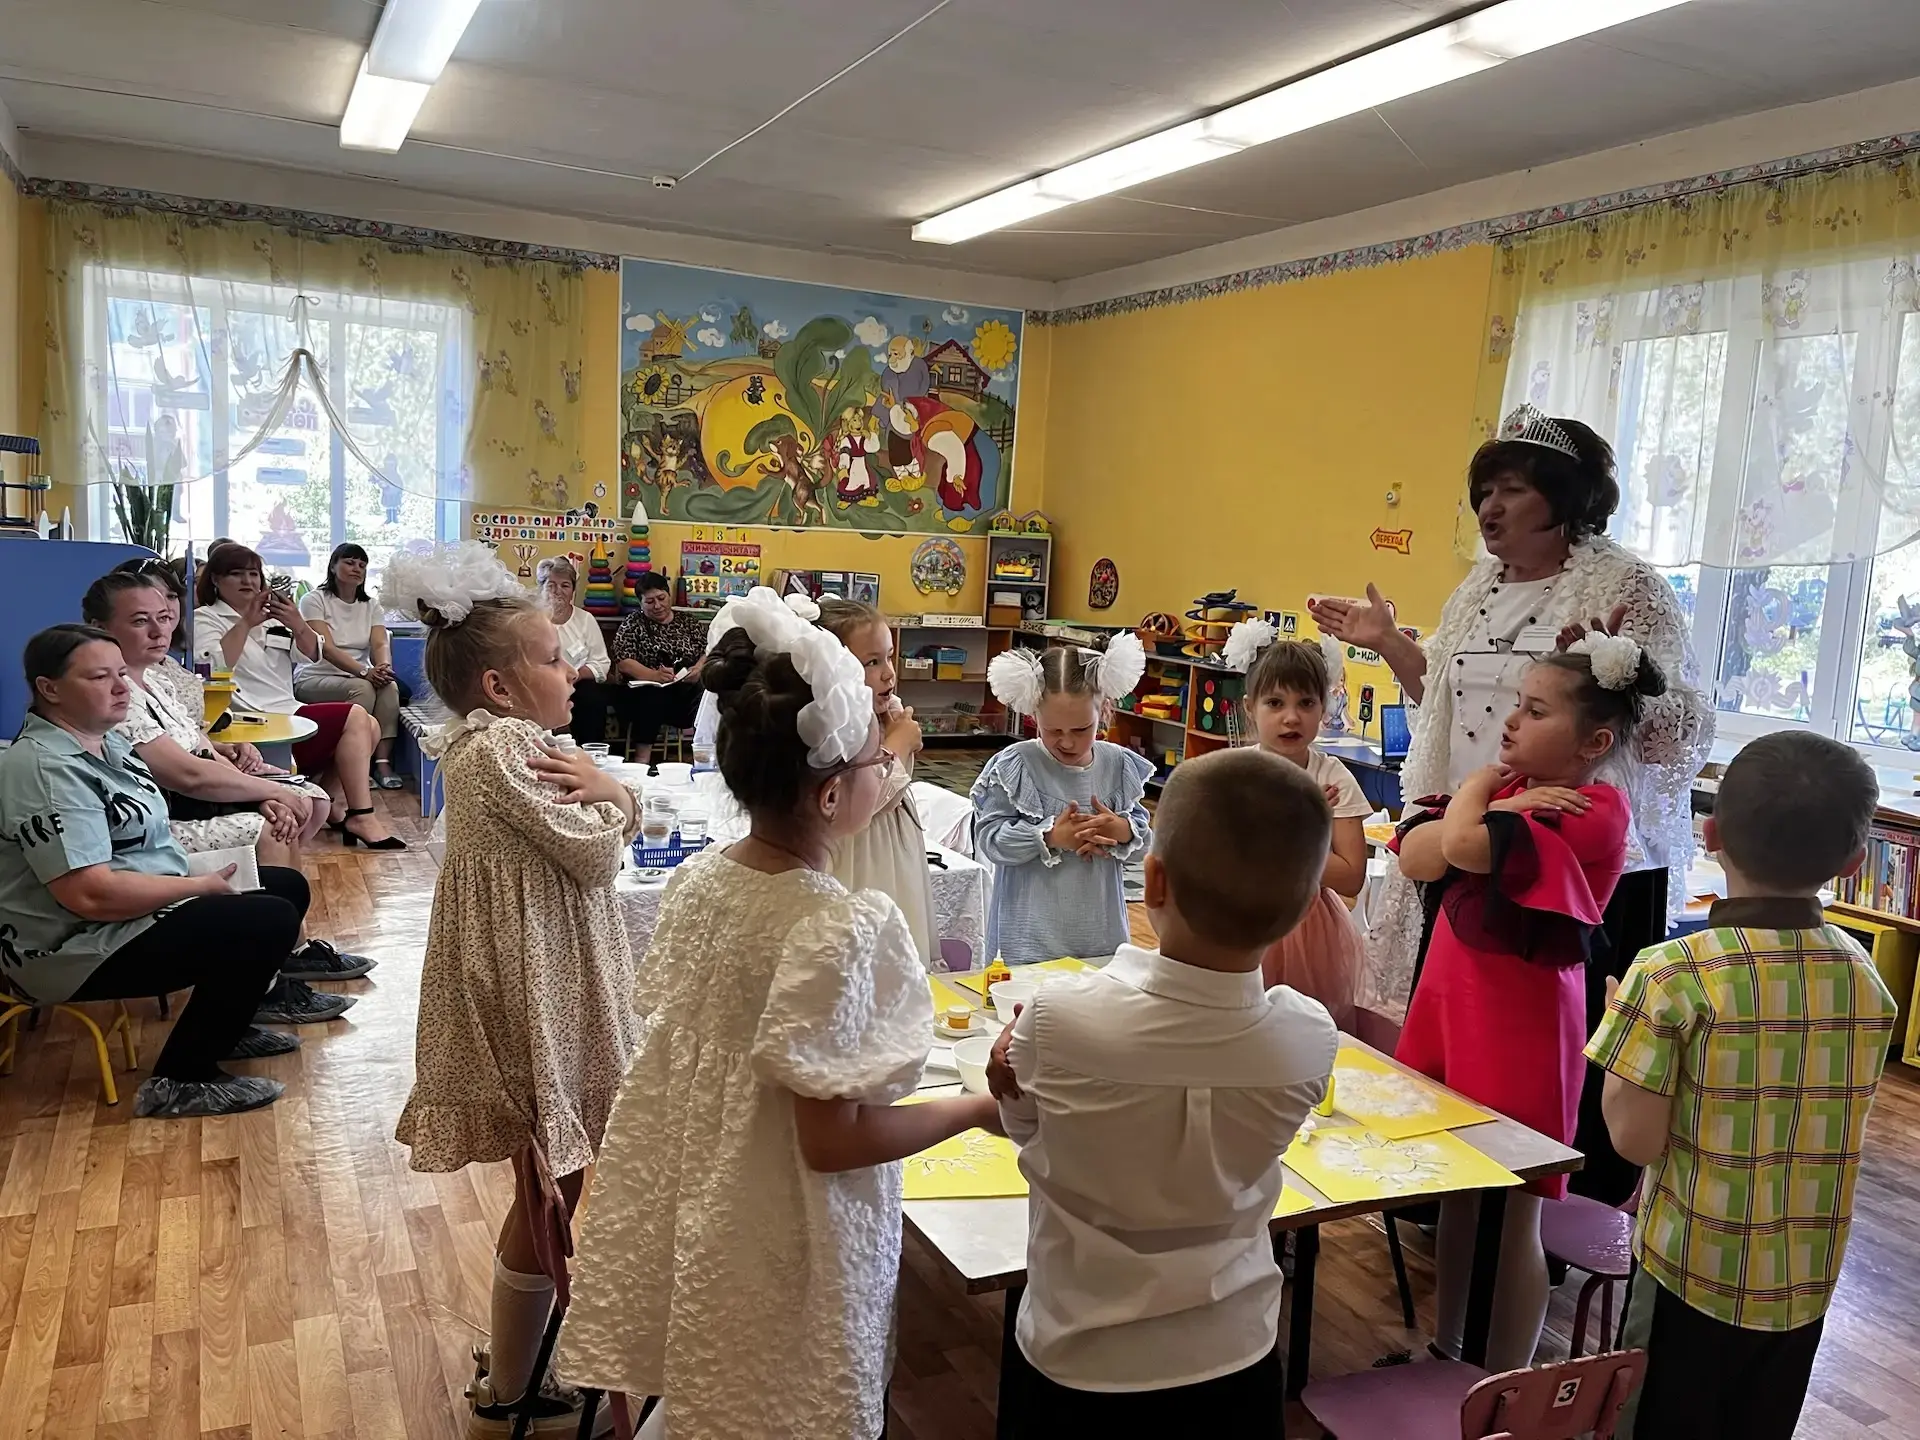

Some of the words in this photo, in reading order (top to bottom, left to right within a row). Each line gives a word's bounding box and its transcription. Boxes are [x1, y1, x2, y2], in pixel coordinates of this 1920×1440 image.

[492, 514, 551, 526] СПОРТОМ
[555, 515, 615, 528] ДРУЖИТЬ
[696, 529, 703, 541] 2
[717, 530, 724, 541] 3
[740, 532, 746, 543] 4
[1376, 533, 1403, 546] ПЕРЕХОД
[722, 558, 733, 574] 2
[721, 579, 731, 593] 4
[1558, 1382, 1577, 1402] 3
